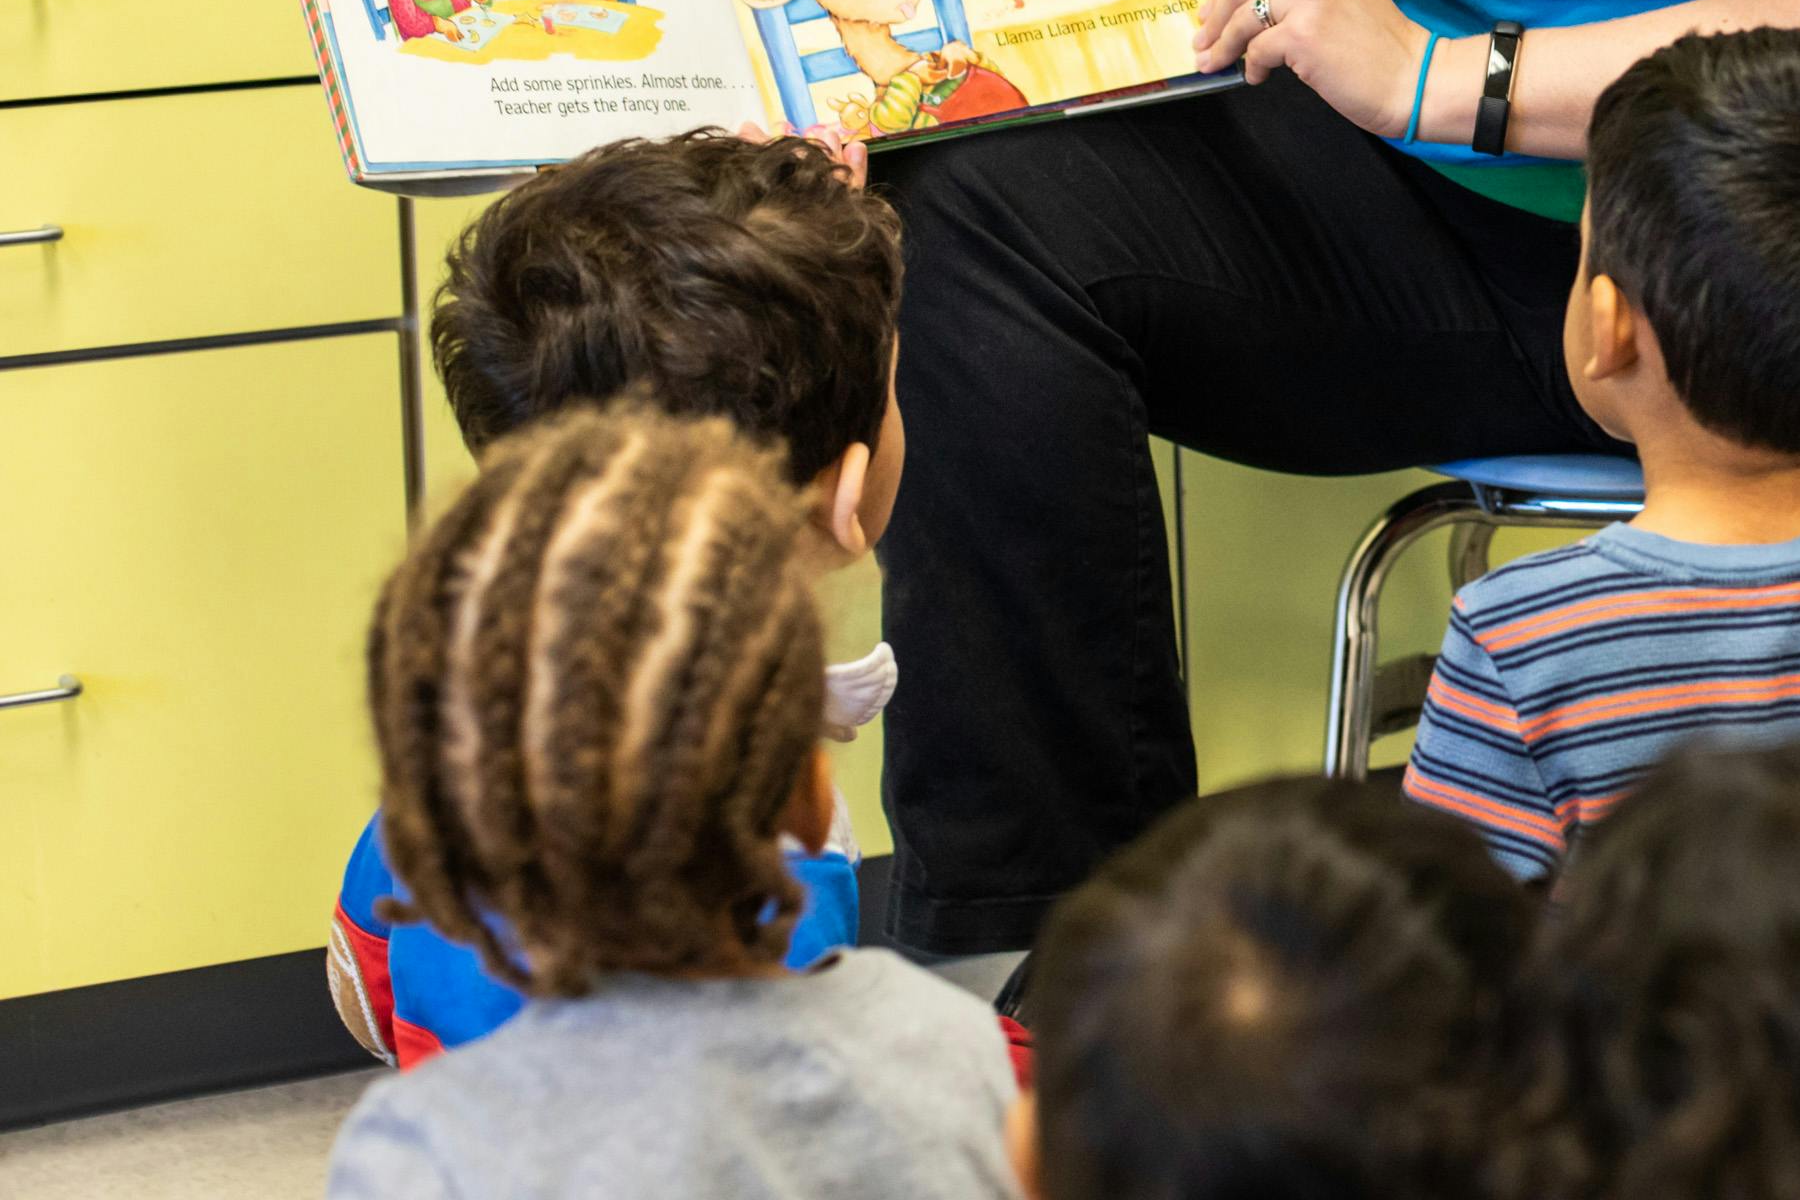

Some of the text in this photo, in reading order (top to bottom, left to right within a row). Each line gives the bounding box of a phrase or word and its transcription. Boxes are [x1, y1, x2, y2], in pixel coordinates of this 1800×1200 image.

[994, 28, 1043, 47] Llama
[1047, 17, 1096, 38] Llama
[490, 77, 520, 93] Add
[523, 79, 562, 92] some
[566, 75, 637, 94] sprinkles.
[641, 73, 689, 89] Almost
[494, 96, 691, 118] Teacher gets the fancy one.
